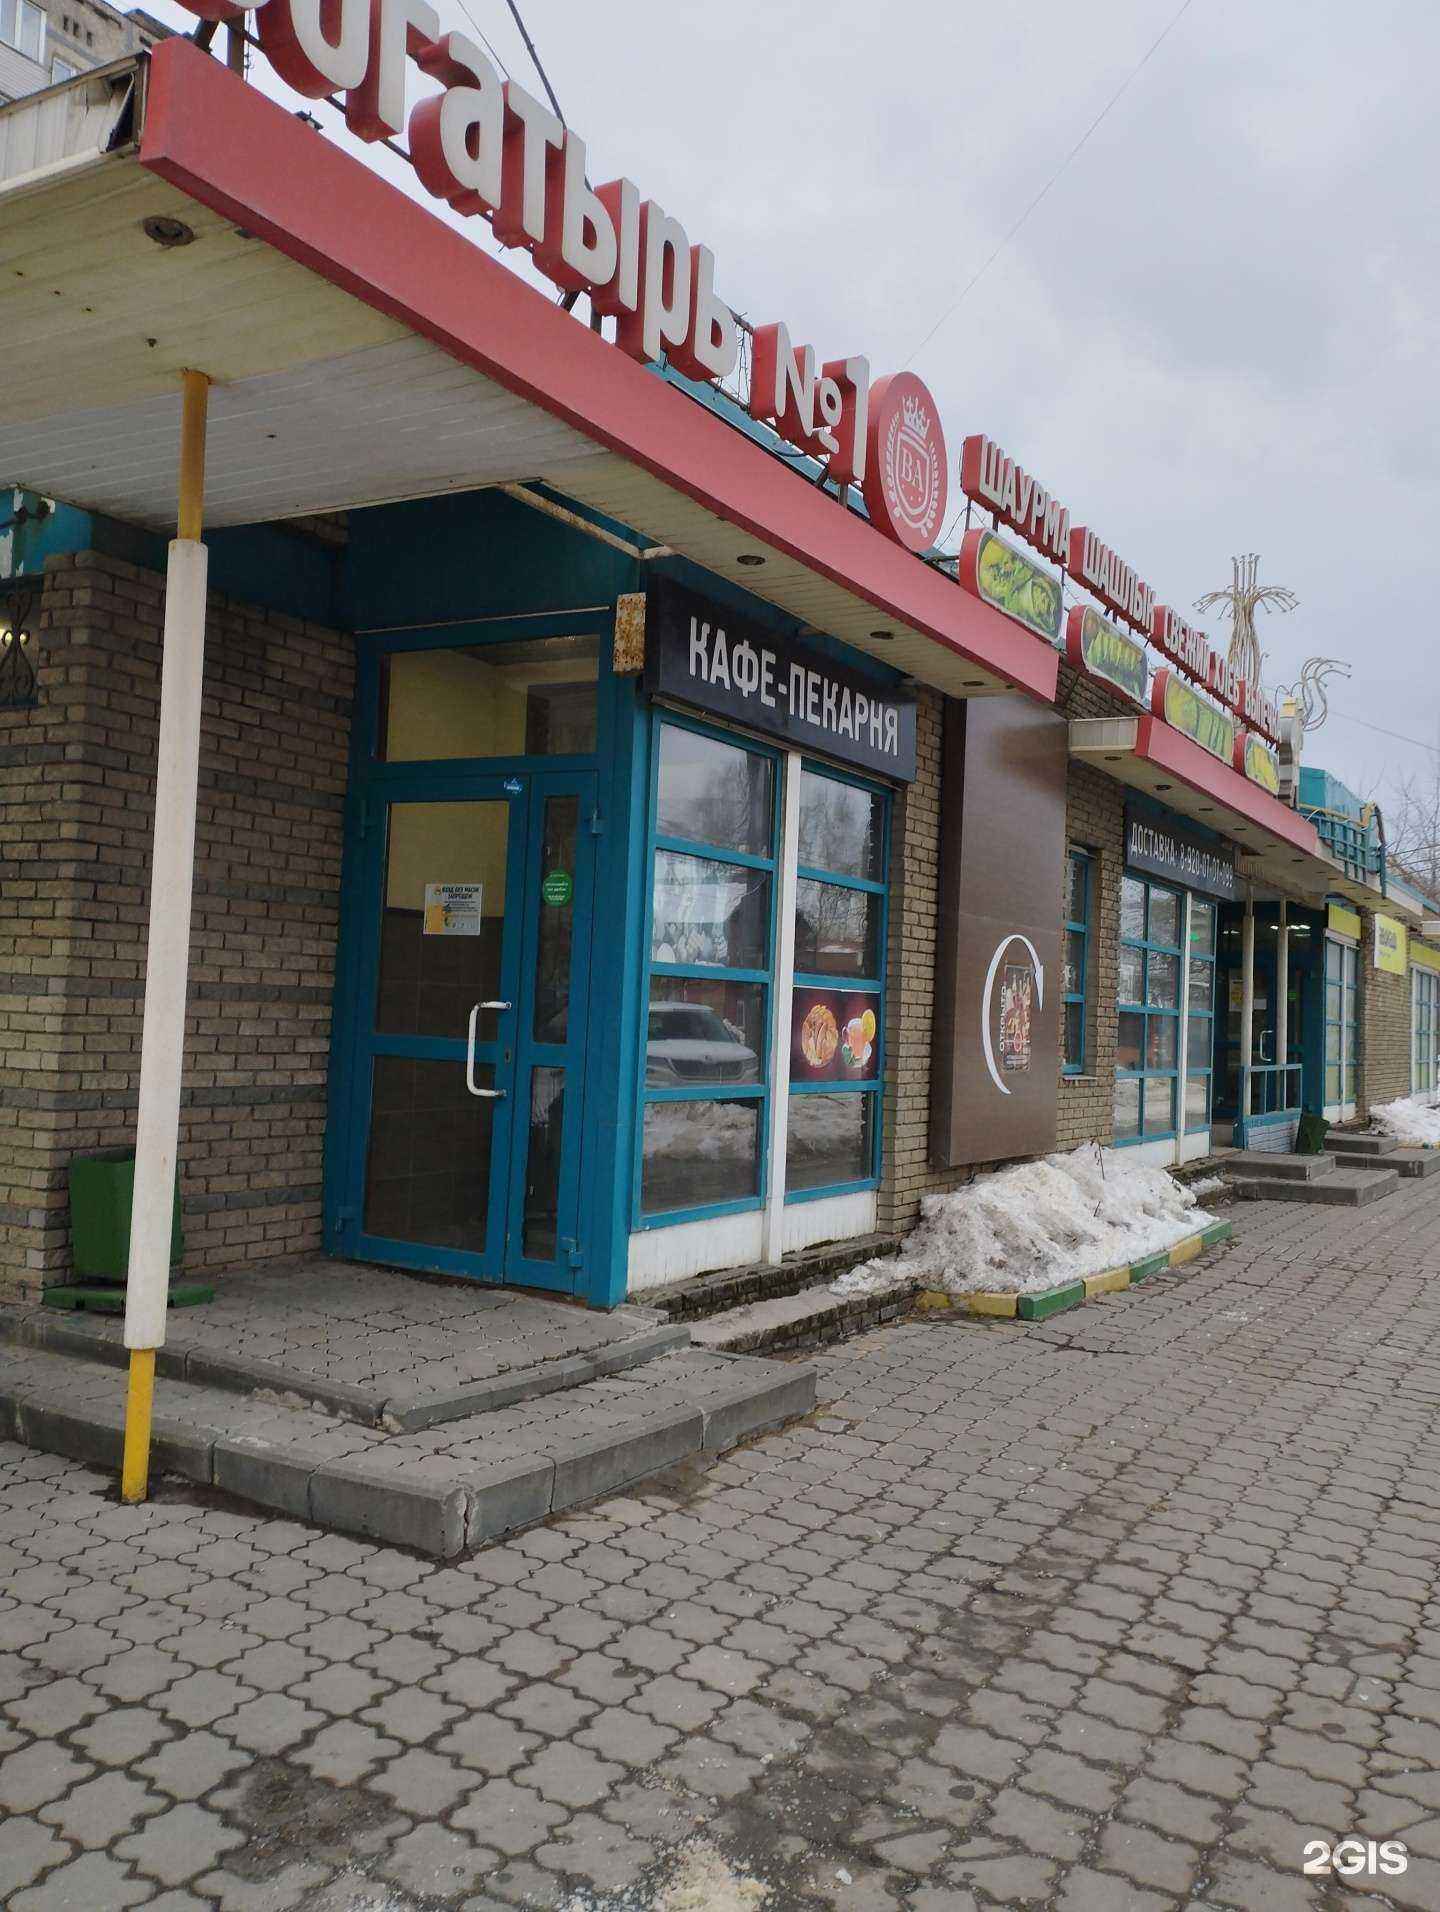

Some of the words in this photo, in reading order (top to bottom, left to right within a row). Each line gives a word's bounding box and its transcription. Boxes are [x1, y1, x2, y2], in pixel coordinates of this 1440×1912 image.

[979, 435, 1070, 564] ШАУРМА
[1082, 528, 1157, 635] ШАШЛЫК
[689, 616, 899, 756] КАФЕ-ПЕКАРНЯ
